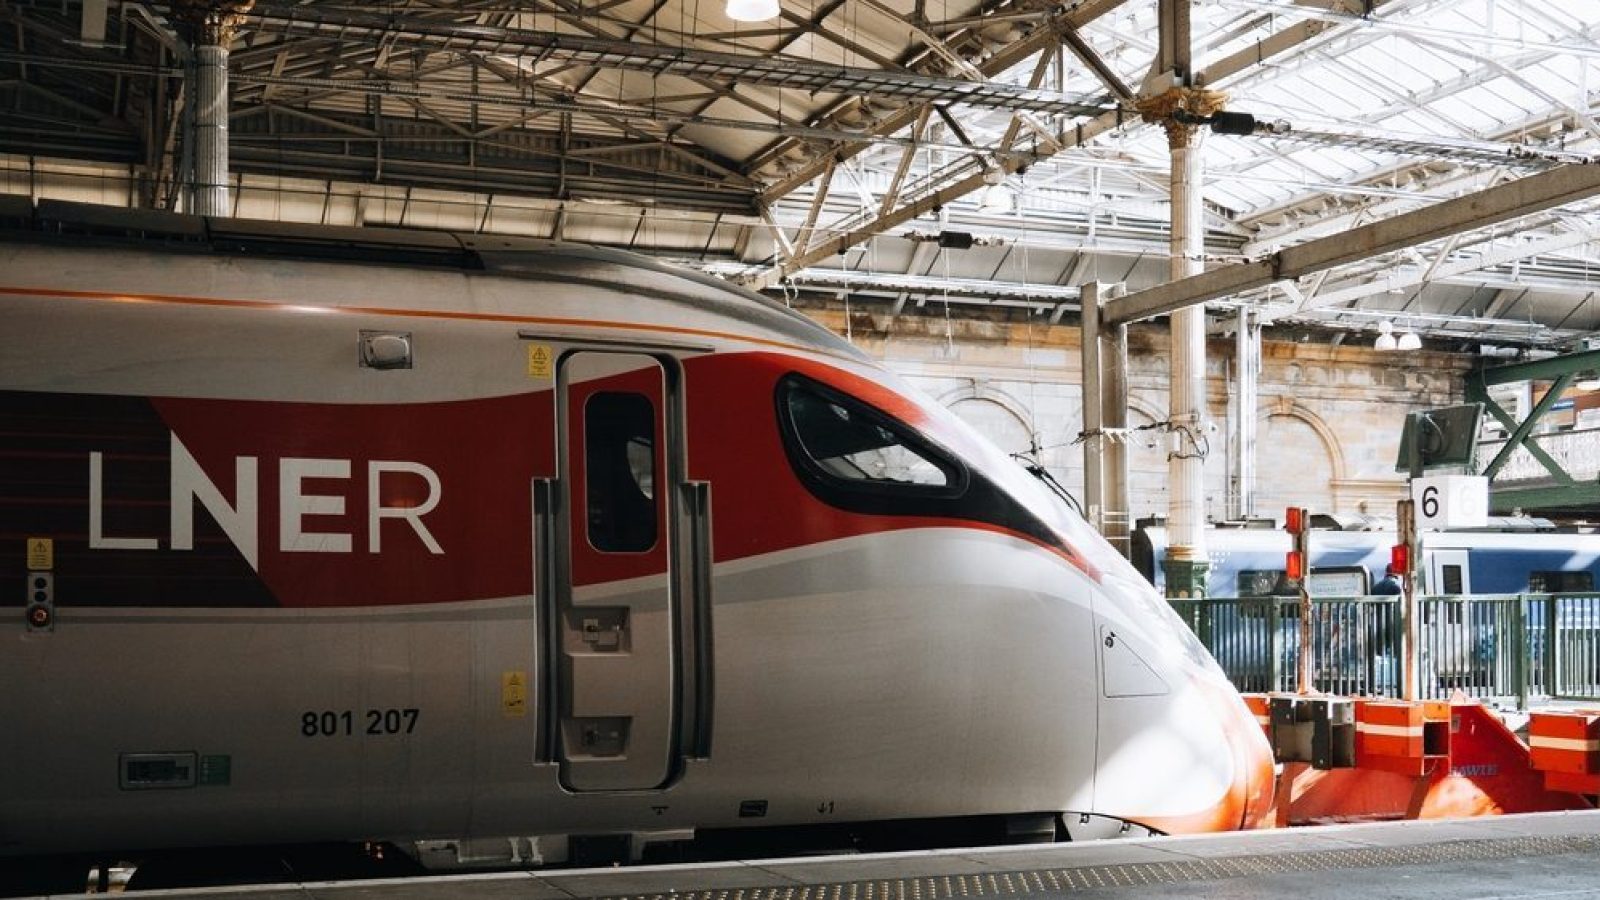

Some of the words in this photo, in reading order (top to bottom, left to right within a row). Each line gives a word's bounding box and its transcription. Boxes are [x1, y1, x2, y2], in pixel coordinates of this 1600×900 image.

[89, 429, 445, 573] LNER
[1422, 485, 1438, 518] 6
[1460, 484, 1477, 516] 6
[301, 710, 352, 736] 801
[366, 708, 420, 734] 207
